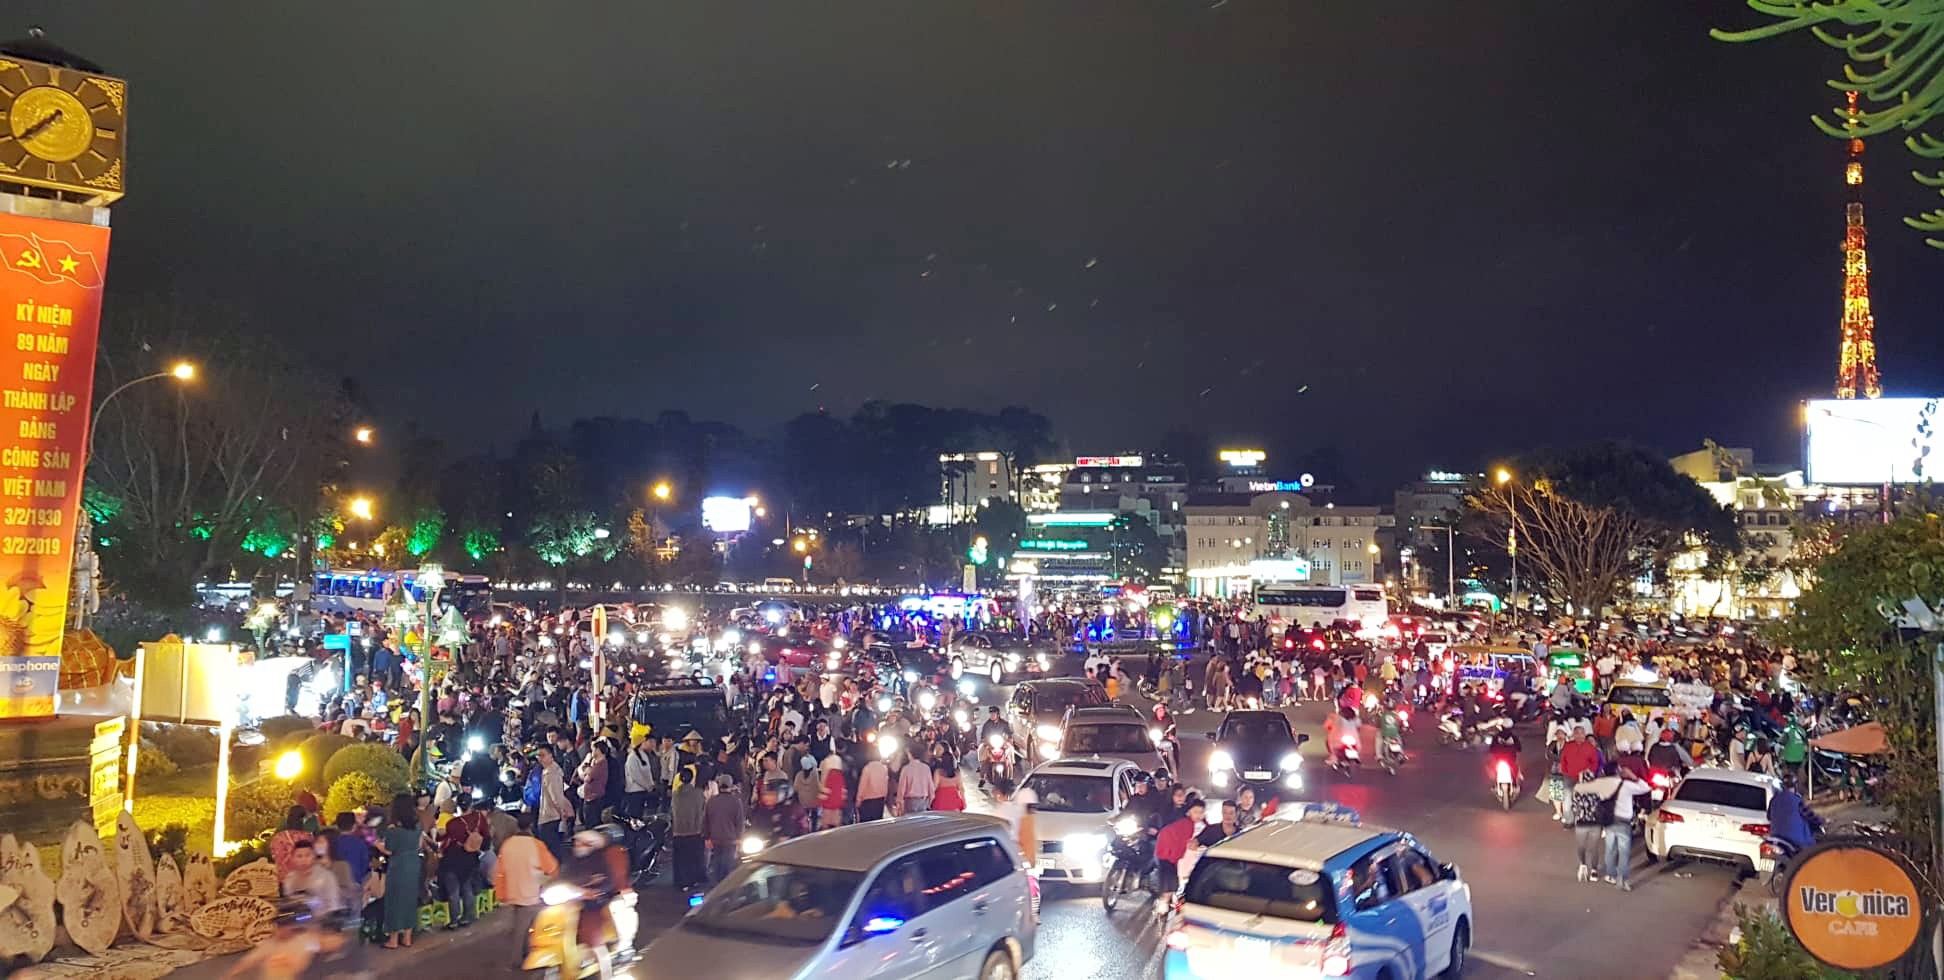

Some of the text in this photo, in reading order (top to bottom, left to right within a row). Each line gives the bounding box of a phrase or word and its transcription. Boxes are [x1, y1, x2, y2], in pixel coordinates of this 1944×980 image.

[16, 299, 72, 328] KỶ NIỆM
[16, 332, 69, 354] 89 NĂM
[23, 360, 60, 382] NGÀY
[3, 388, 76, 416] THÀNH LẬP
[19, 415, 57, 440] ĐẢNG
[2, 446, 71, 472] CỘNG SẢN
[3, 475, 66, 500] VIỆT NAM
[4, 507, 62, 527] 3/2/1930
[2, 536, 61, 555] 3/2/2019
